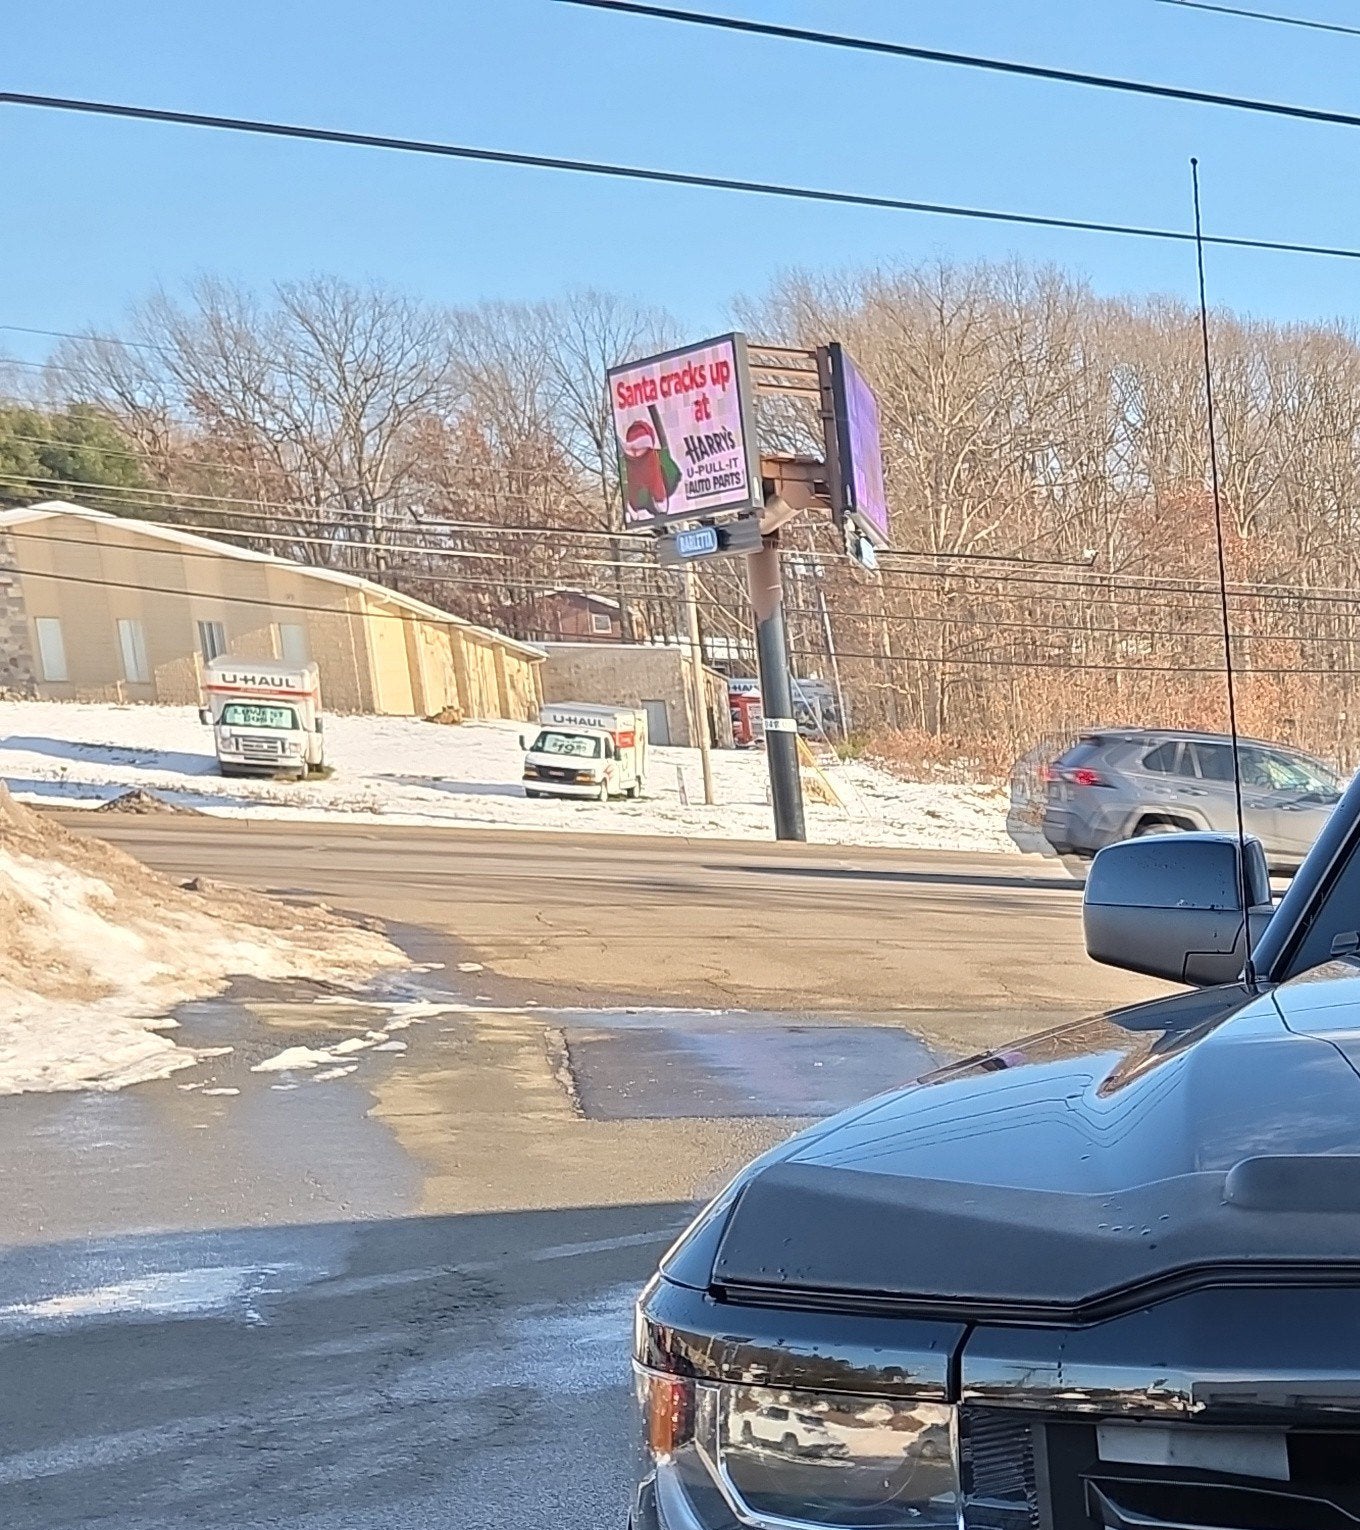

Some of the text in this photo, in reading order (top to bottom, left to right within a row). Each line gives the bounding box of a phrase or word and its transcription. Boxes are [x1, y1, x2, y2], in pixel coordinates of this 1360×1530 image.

[616, 360, 730, 409] Santa cracks up
[694, 393, 711, 422] at
[683, 425, 736, 465] HARRY'S
[687, 457, 739, 478] U-PULL-IT
[688, 471, 741, 495] AUTO PARTS
[221, 673, 296, 688] U-HAUL
[553, 714, 606, 727] U-HAUL
